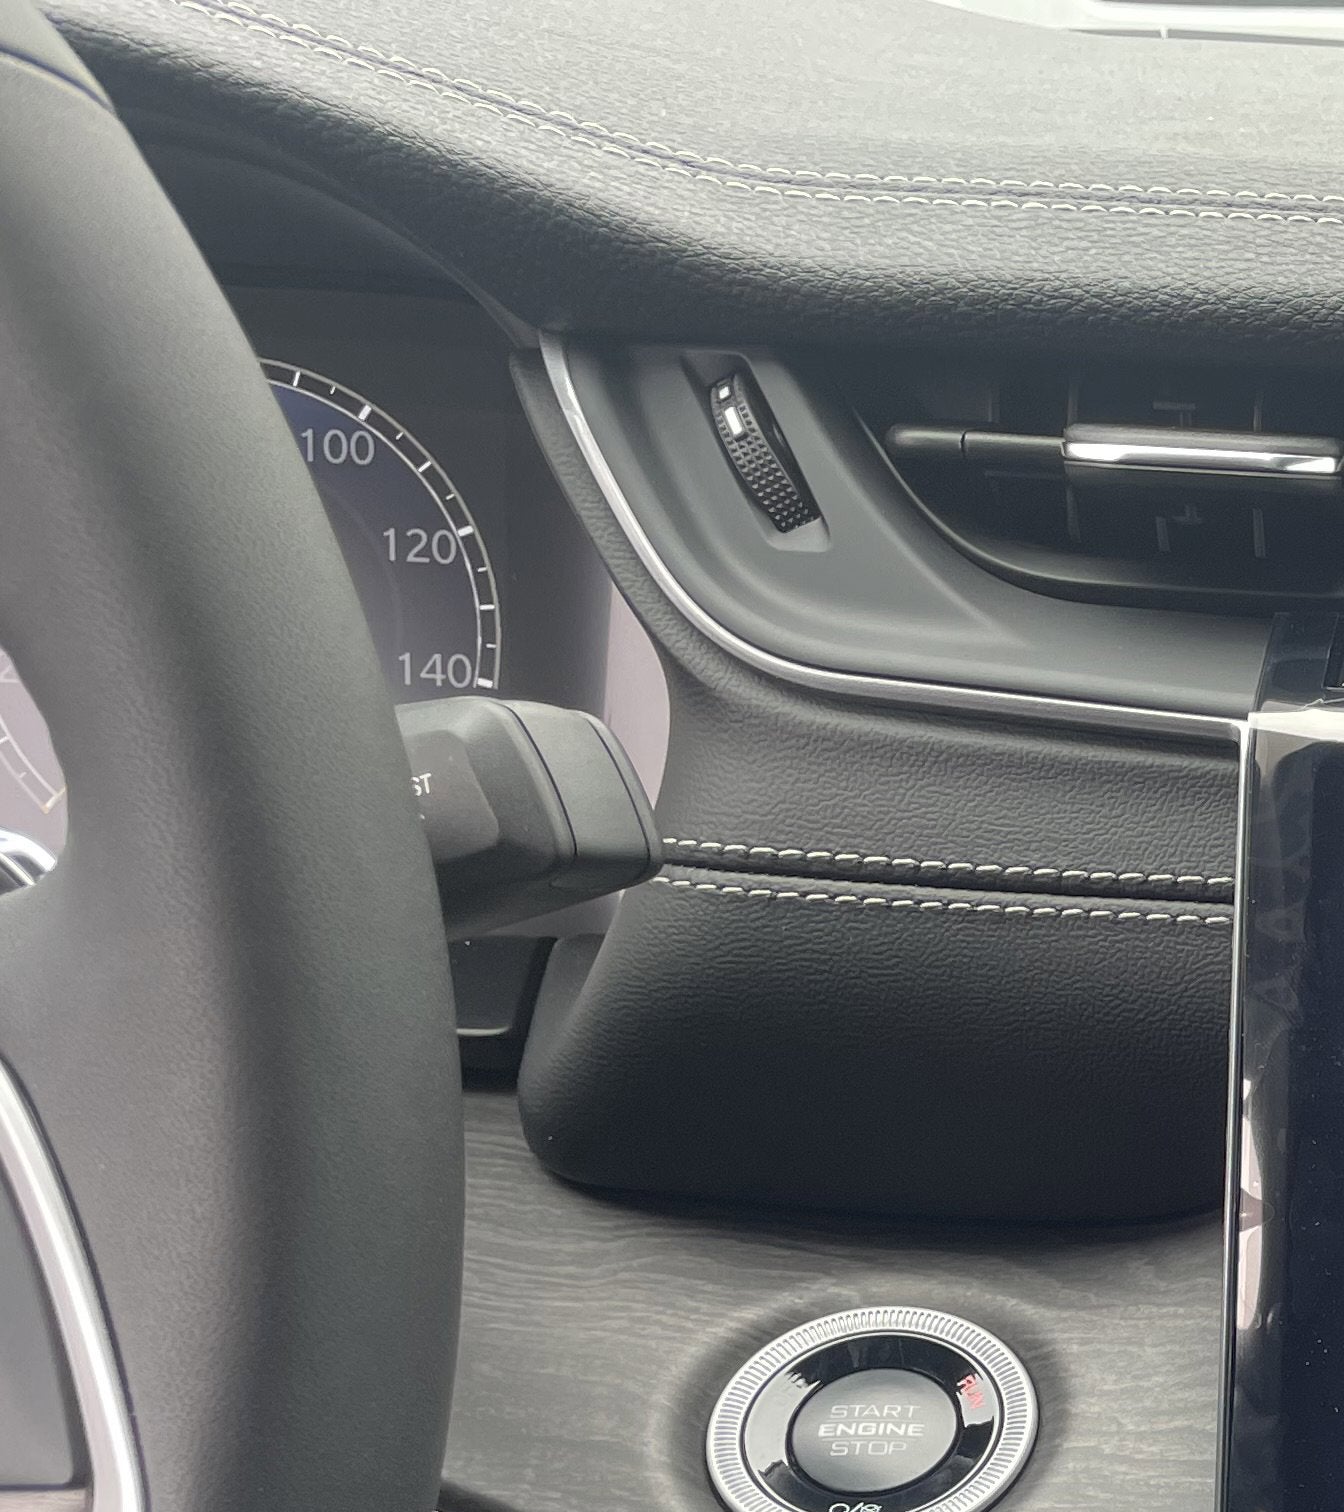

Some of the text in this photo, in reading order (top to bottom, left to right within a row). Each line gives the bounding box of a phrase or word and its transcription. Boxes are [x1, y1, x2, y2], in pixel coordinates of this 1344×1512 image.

[299, 427, 377, 468] 100
[382, 526, 458, 565] 120
[397, 650, 473, 689] 140
[829, 1404, 922, 1419] START
[817, 1422, 926, 1438] ENGINE
[829, 1440, 908, 1457] STOP
